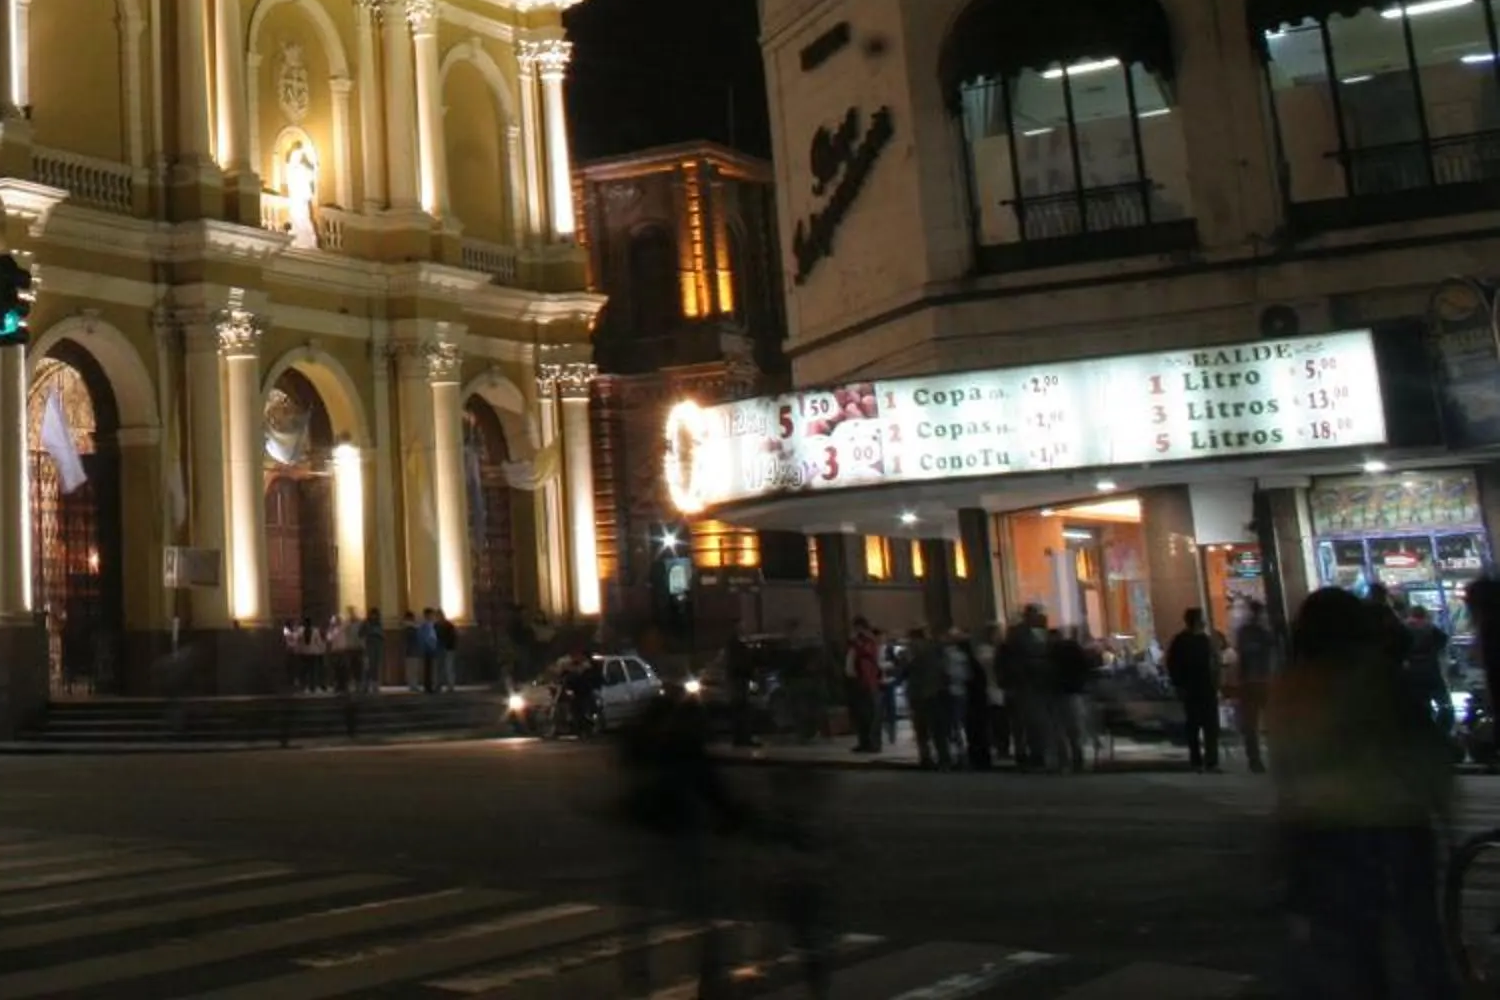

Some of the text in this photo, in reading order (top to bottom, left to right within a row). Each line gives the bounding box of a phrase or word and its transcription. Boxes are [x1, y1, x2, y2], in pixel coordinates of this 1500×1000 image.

[1193, 343, 1293, 368] BALDE
[1149, 375, 1165, 395] 1
[1182, 369, 1262, 392] Litro
[884, 391, 897, 409] 1
[913, 387, 982, 408] Copa
[779, 405, 794, 439] 5
[810, 398, 830, 415] 50
[1152, 404, 1168, 425] 3
[1187, 398, 1280, 421] Litros
[916, 419, 991, 440] Copas
[1155, 432, 1171, 453] 5
[1190, 428, 1284, 451] Litros
[821, 446, 839, 481] 3
